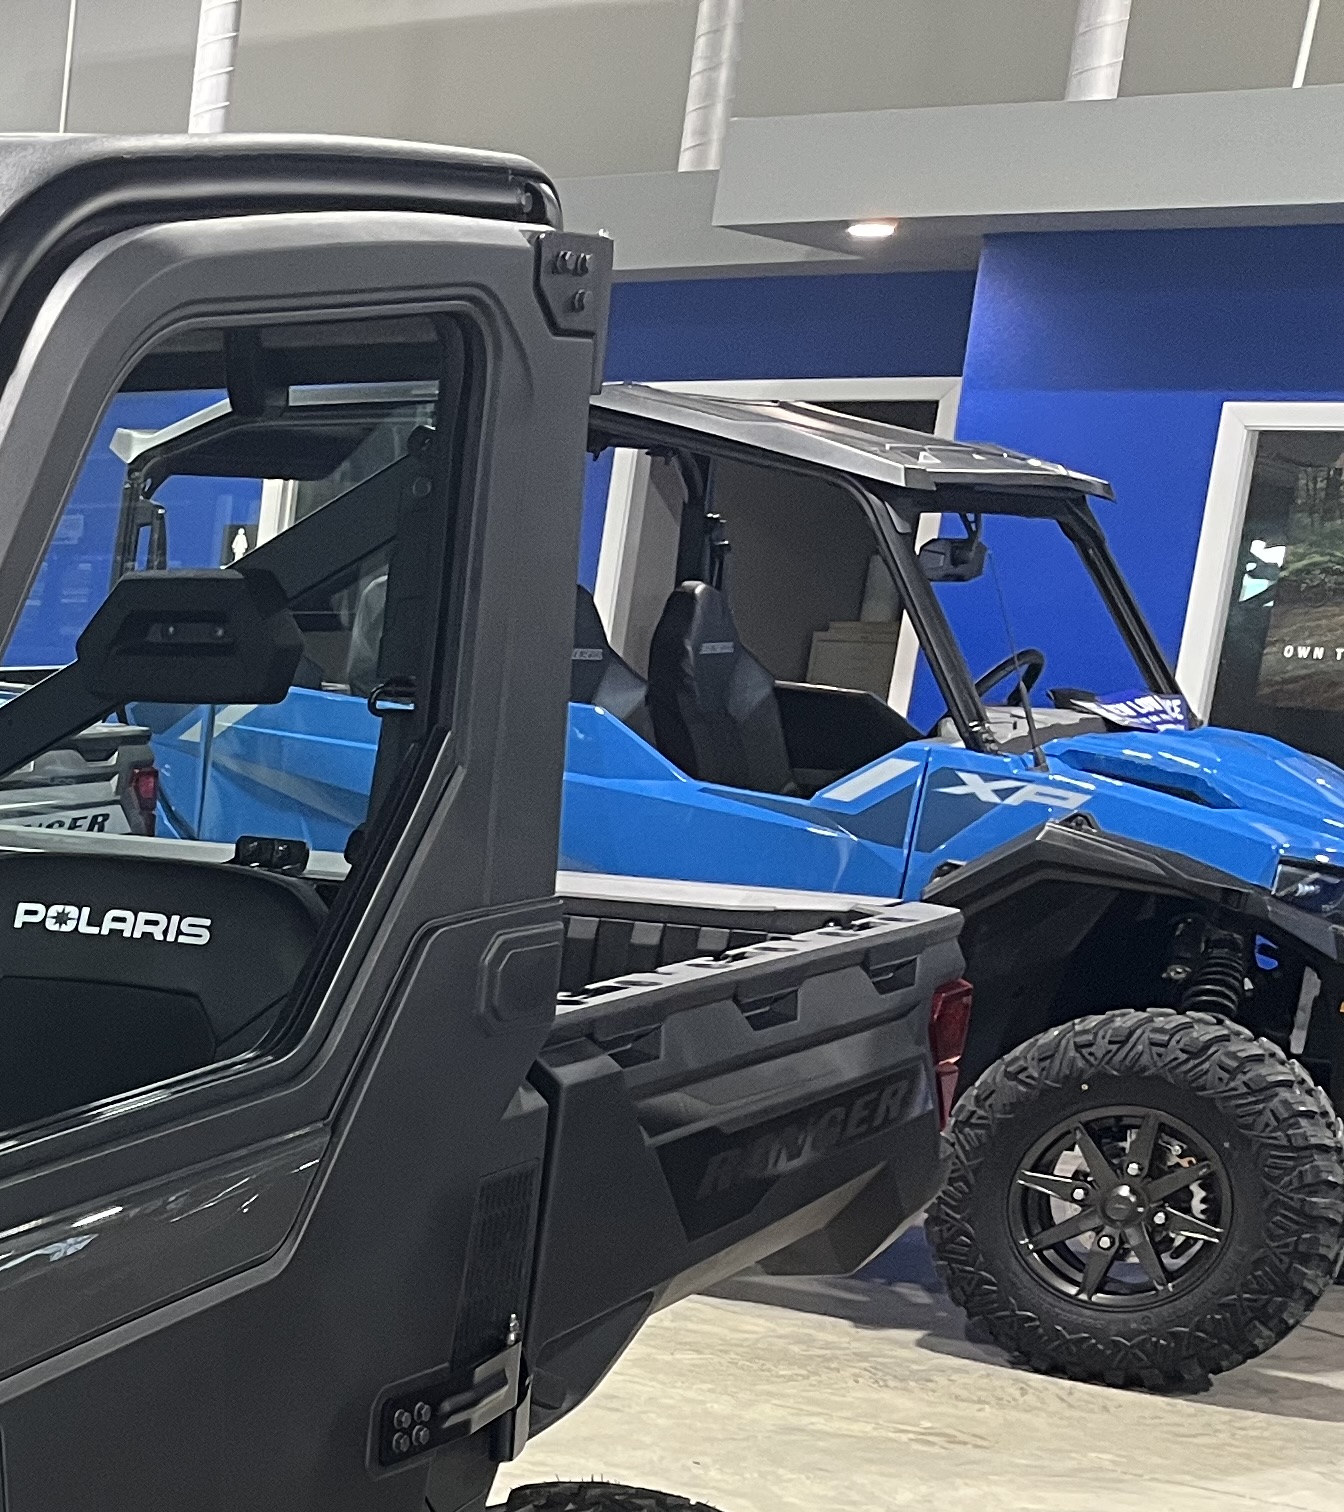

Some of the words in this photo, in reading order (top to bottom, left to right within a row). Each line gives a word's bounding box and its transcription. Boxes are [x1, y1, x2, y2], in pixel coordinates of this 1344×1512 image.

[1283, 644, 1325, 660] OWN
[933, 770, 1093, 810] XP
[13, 901, 212, 946] POLARIS
[697, 1078, 912, 1199] RANGER
